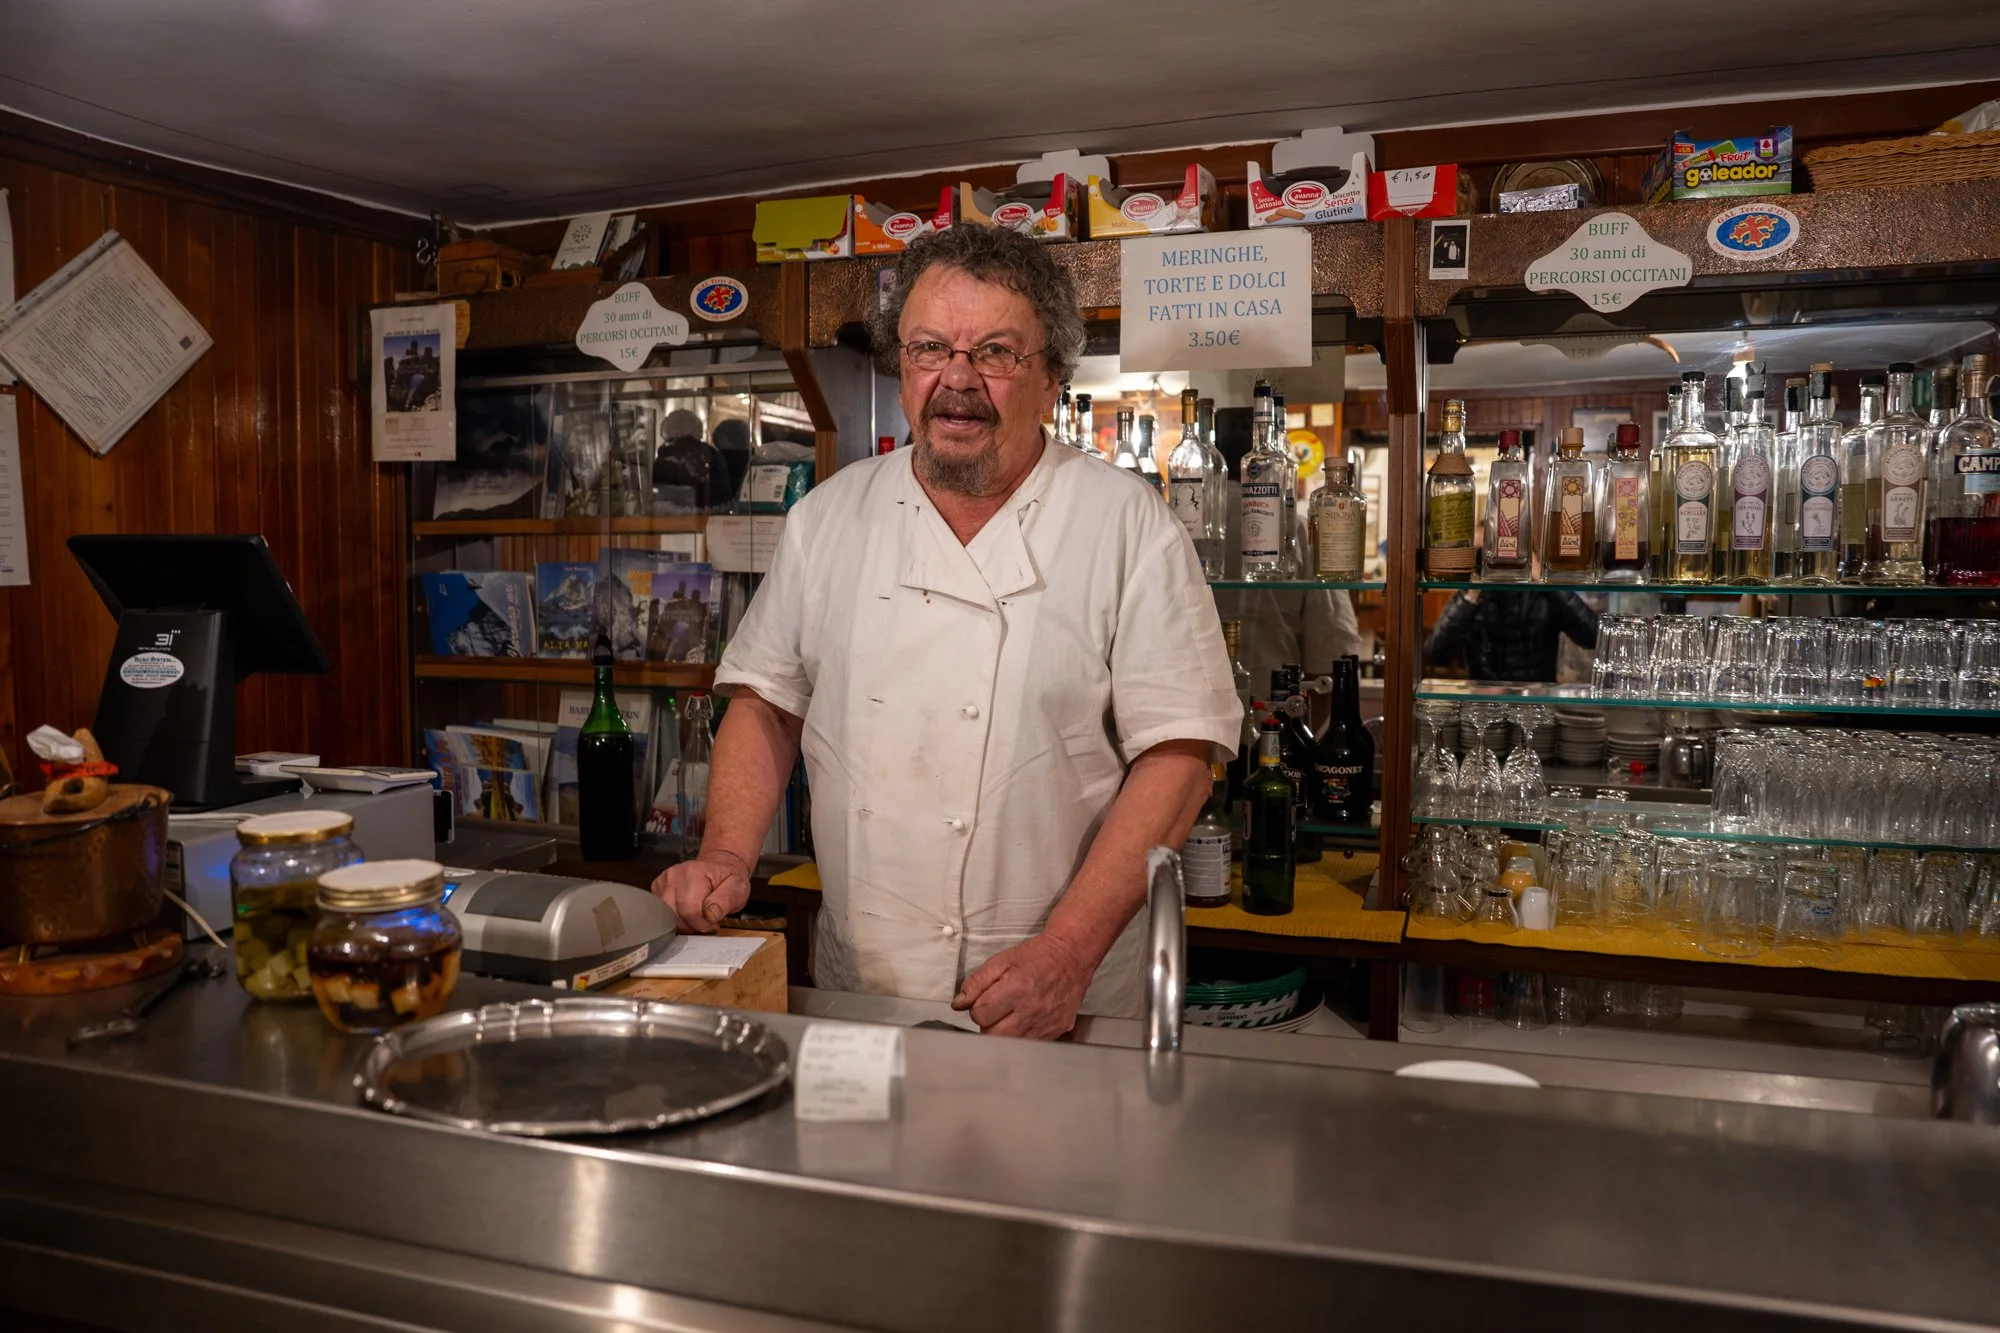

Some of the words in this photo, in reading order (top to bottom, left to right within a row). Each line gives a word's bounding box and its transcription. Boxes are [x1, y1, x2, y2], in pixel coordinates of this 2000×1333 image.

[1332, 190, 1361, 200] biscotto
[1255, 199, 1282, 210] Lattosio
[1324, 197, 1355, 208] Senza
[1315, 206, 1354, 220] Glutine
[1717, 211, 1736, 224] GAL
[1587, 221, 1630, 237] BUFF
[1161, 245, 1268, 268] MERINGHE,
[1570, 246, 1589, 260] 30
[1593, 245, 1627, 260] anni
[1631, 244, 1646, 259] di
[1528, 269, 1606, 286] PERCORSI
[1610, 266, 1688, 283] OCCITANI
[1144, 276, 1206, 296] TORTE
[1212, 275, 1223, 291] E
[1228, 271, 1287, 290] DOLCI
[614, 291, 641, 304] BUFF
[1592, 291, 1622, 306] 15€
[604, 312, 616, 323] 30
[618, 310, 640, 322] anni
[642, 308, 652, 320] di
[1149, 303, 1203, 322] FATTI
[1208, 302, 1229, 319] IN
[1234, 298, 1283, 317] CASA
[580, 330, 628, 344] PERCORSI
[630, 325, 678, 339] OCCITANI
[1188, 330, 1241, 348] 3.50€
[619, 347, 639, 359] 15€
[1958, 456, 2000, 472] CAMP
[1244, 486, 1277, 495] MAZZOTTI
[1325, 511, 1356, 519] SIBONA
[543, 640, 571, 650] ALTA
[569, 705, 590, 715] BABY
[1314, 762, 1364, 775] DRAGONET
